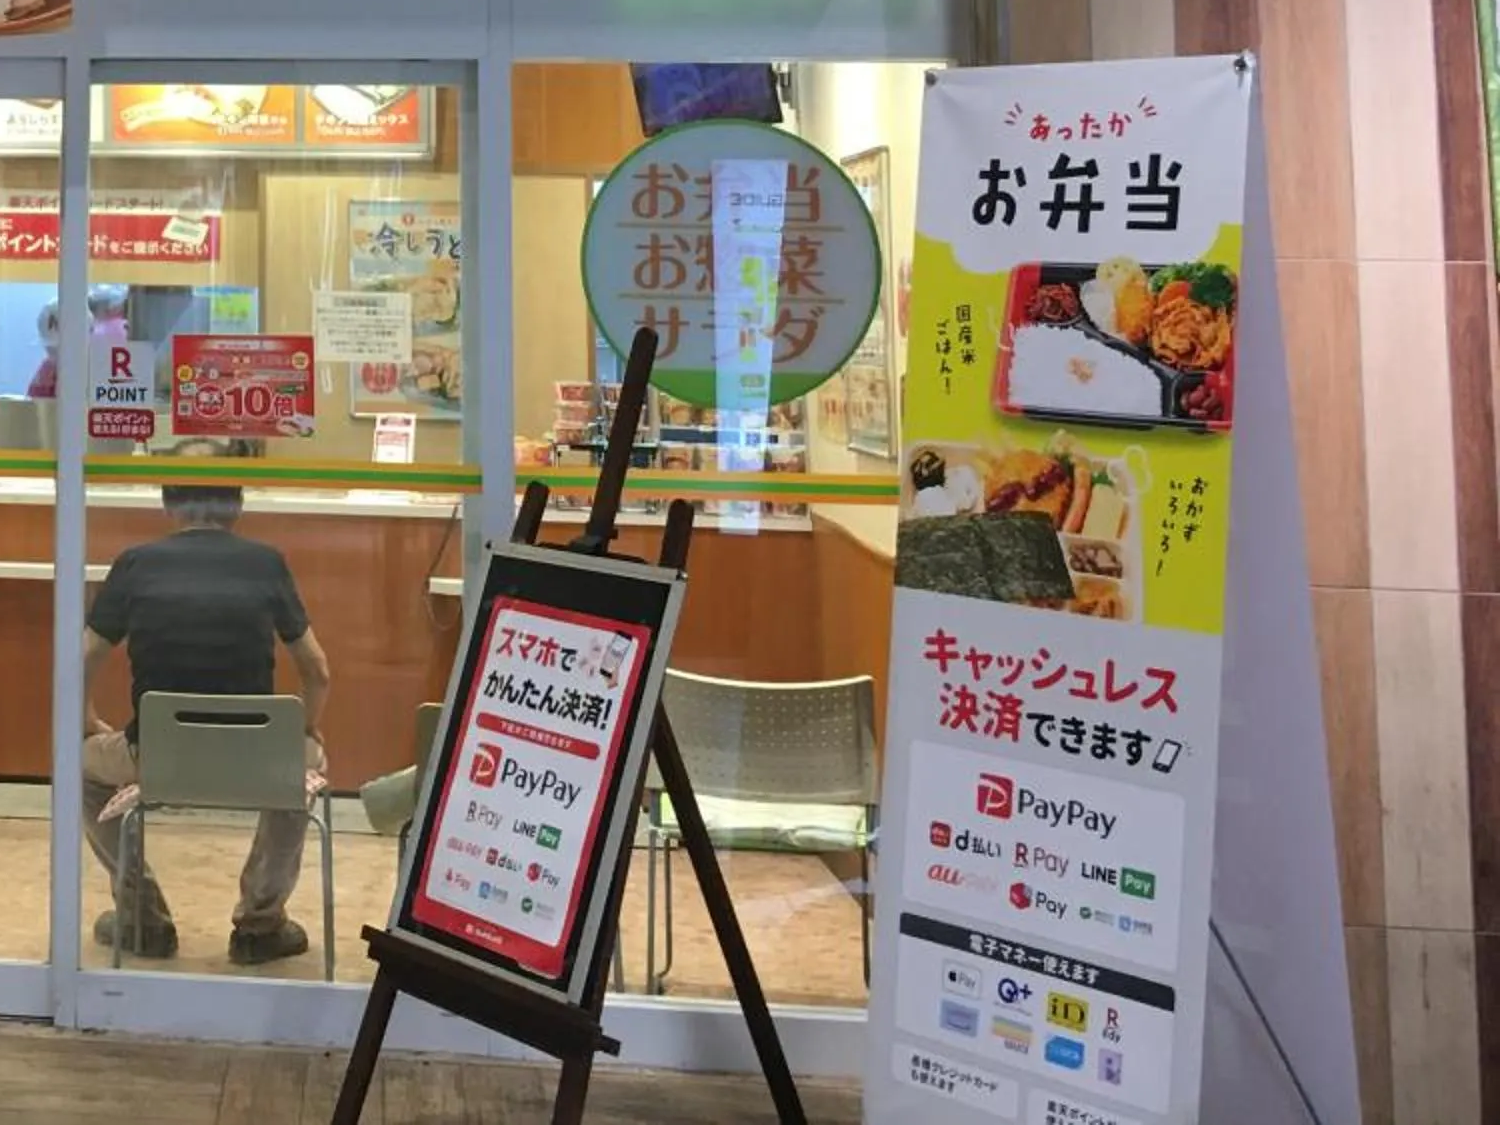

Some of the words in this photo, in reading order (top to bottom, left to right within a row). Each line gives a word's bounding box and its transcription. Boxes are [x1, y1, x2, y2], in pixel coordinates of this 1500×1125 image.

[1029, 112, 1133, 141] あったか
[972, 152, 1183, 234] お弁当
[955, 304, 977, 366] 国産米
[95, 385, 149, 403] POINT
[1182, 476, 1209, 544] おかず
[495, 628, 578, 673] スマホで
[924, 628, 1178, 713] キャッシュレス
[482, 672, 615, 731] かんたん決済!
[938, 682, 1155, 765] 決済できます
[501, 756, 583, 810] PayPay
[477, 804, 504, 831] Pay
[512, 818, 537, 838] LINE
[1017, 787, 1117, 839] PayPay
[954, 829, 1001, 860] d払い
[1033, 846, 1070, 879] Pay
[541, 866, 561, 890] Pay
[1080, 862, 1118, 886] LINE
[1123, 874, 1153, 894] Pay
[1035, 890, 1068, 920] Pay
[968, 932, 1102, 985] 電子マネー使えます
